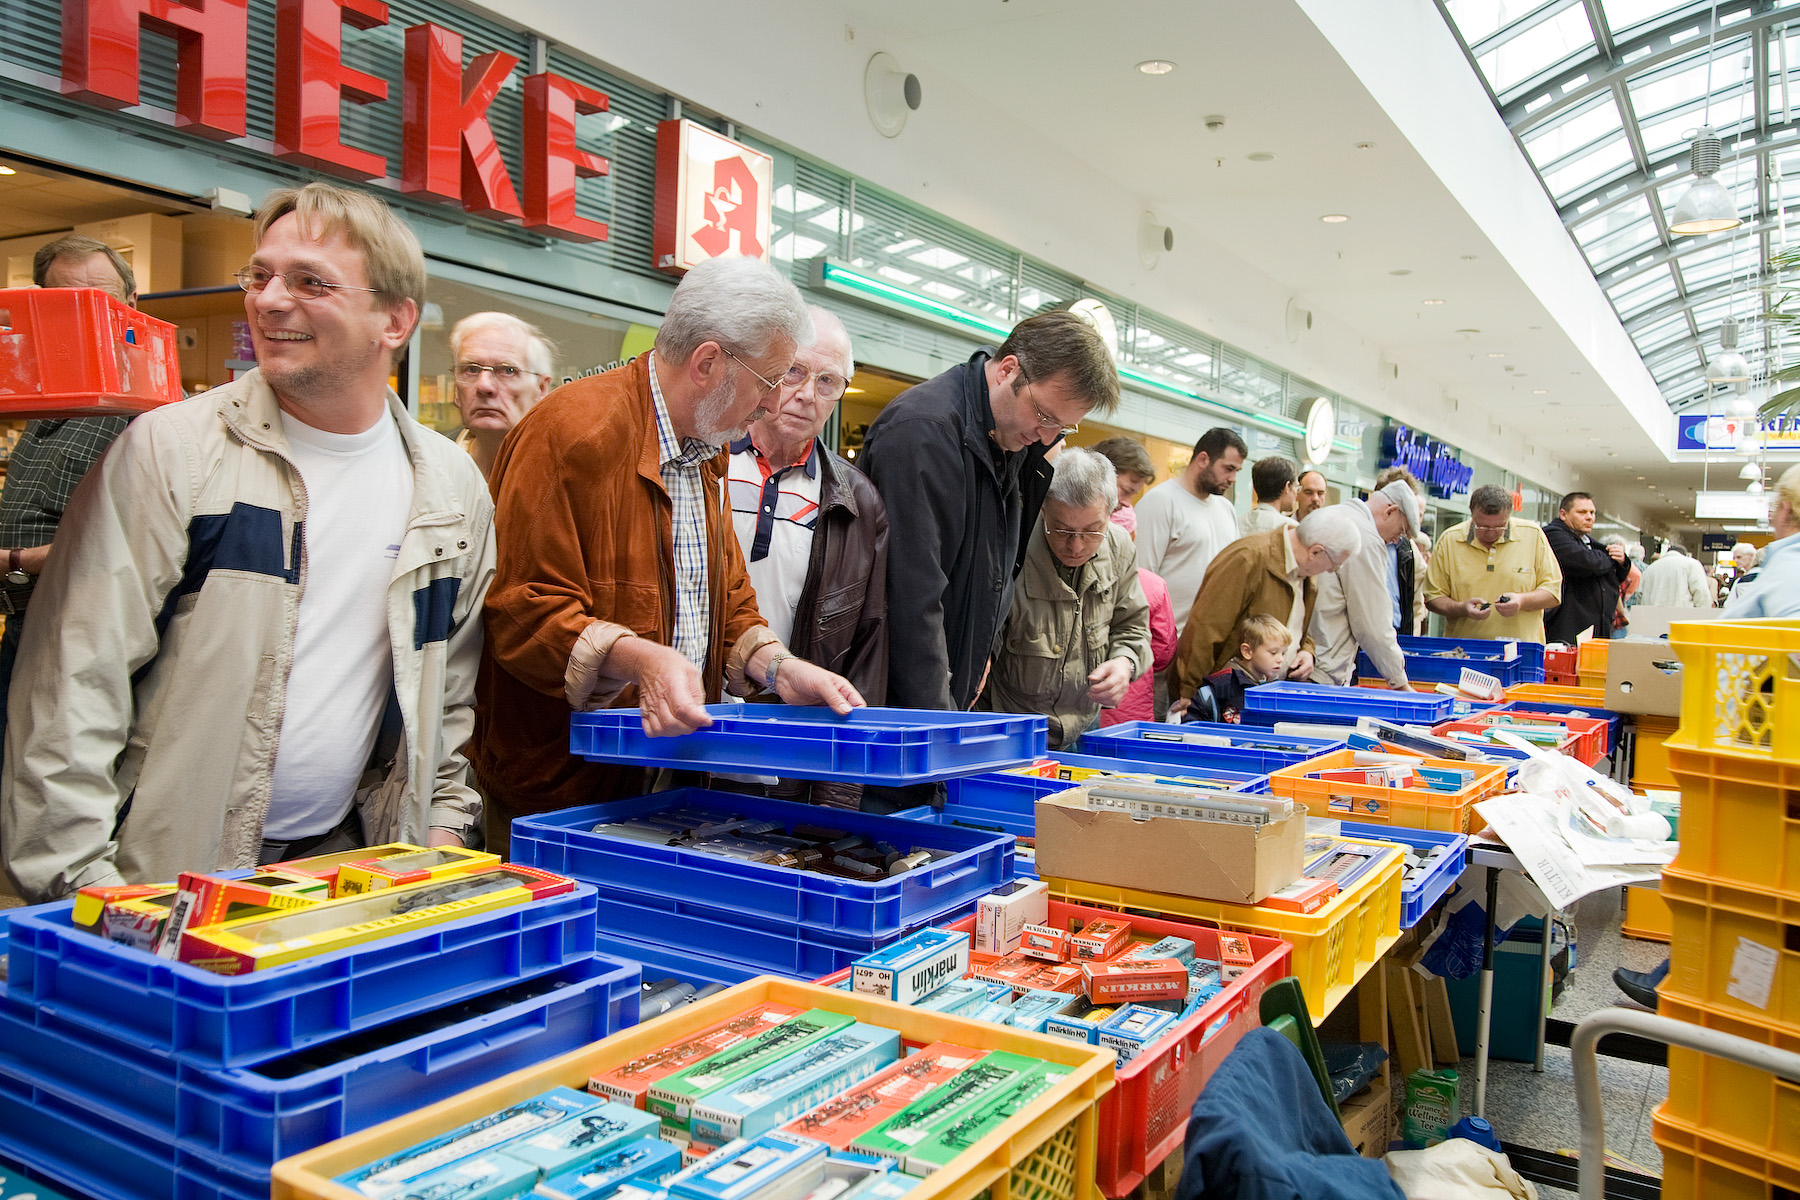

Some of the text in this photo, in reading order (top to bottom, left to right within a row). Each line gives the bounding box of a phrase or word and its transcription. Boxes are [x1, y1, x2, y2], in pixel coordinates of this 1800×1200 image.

[1536, 858, 1574, 900] KULTUR
[1048, 1025, 1075, 1037] märklin
[1101, 1035, 1129, 1048] märklin
[1408, 1108, 1447, 1125] Wellness
[1420, 1119, 1435, 1131] Tee
